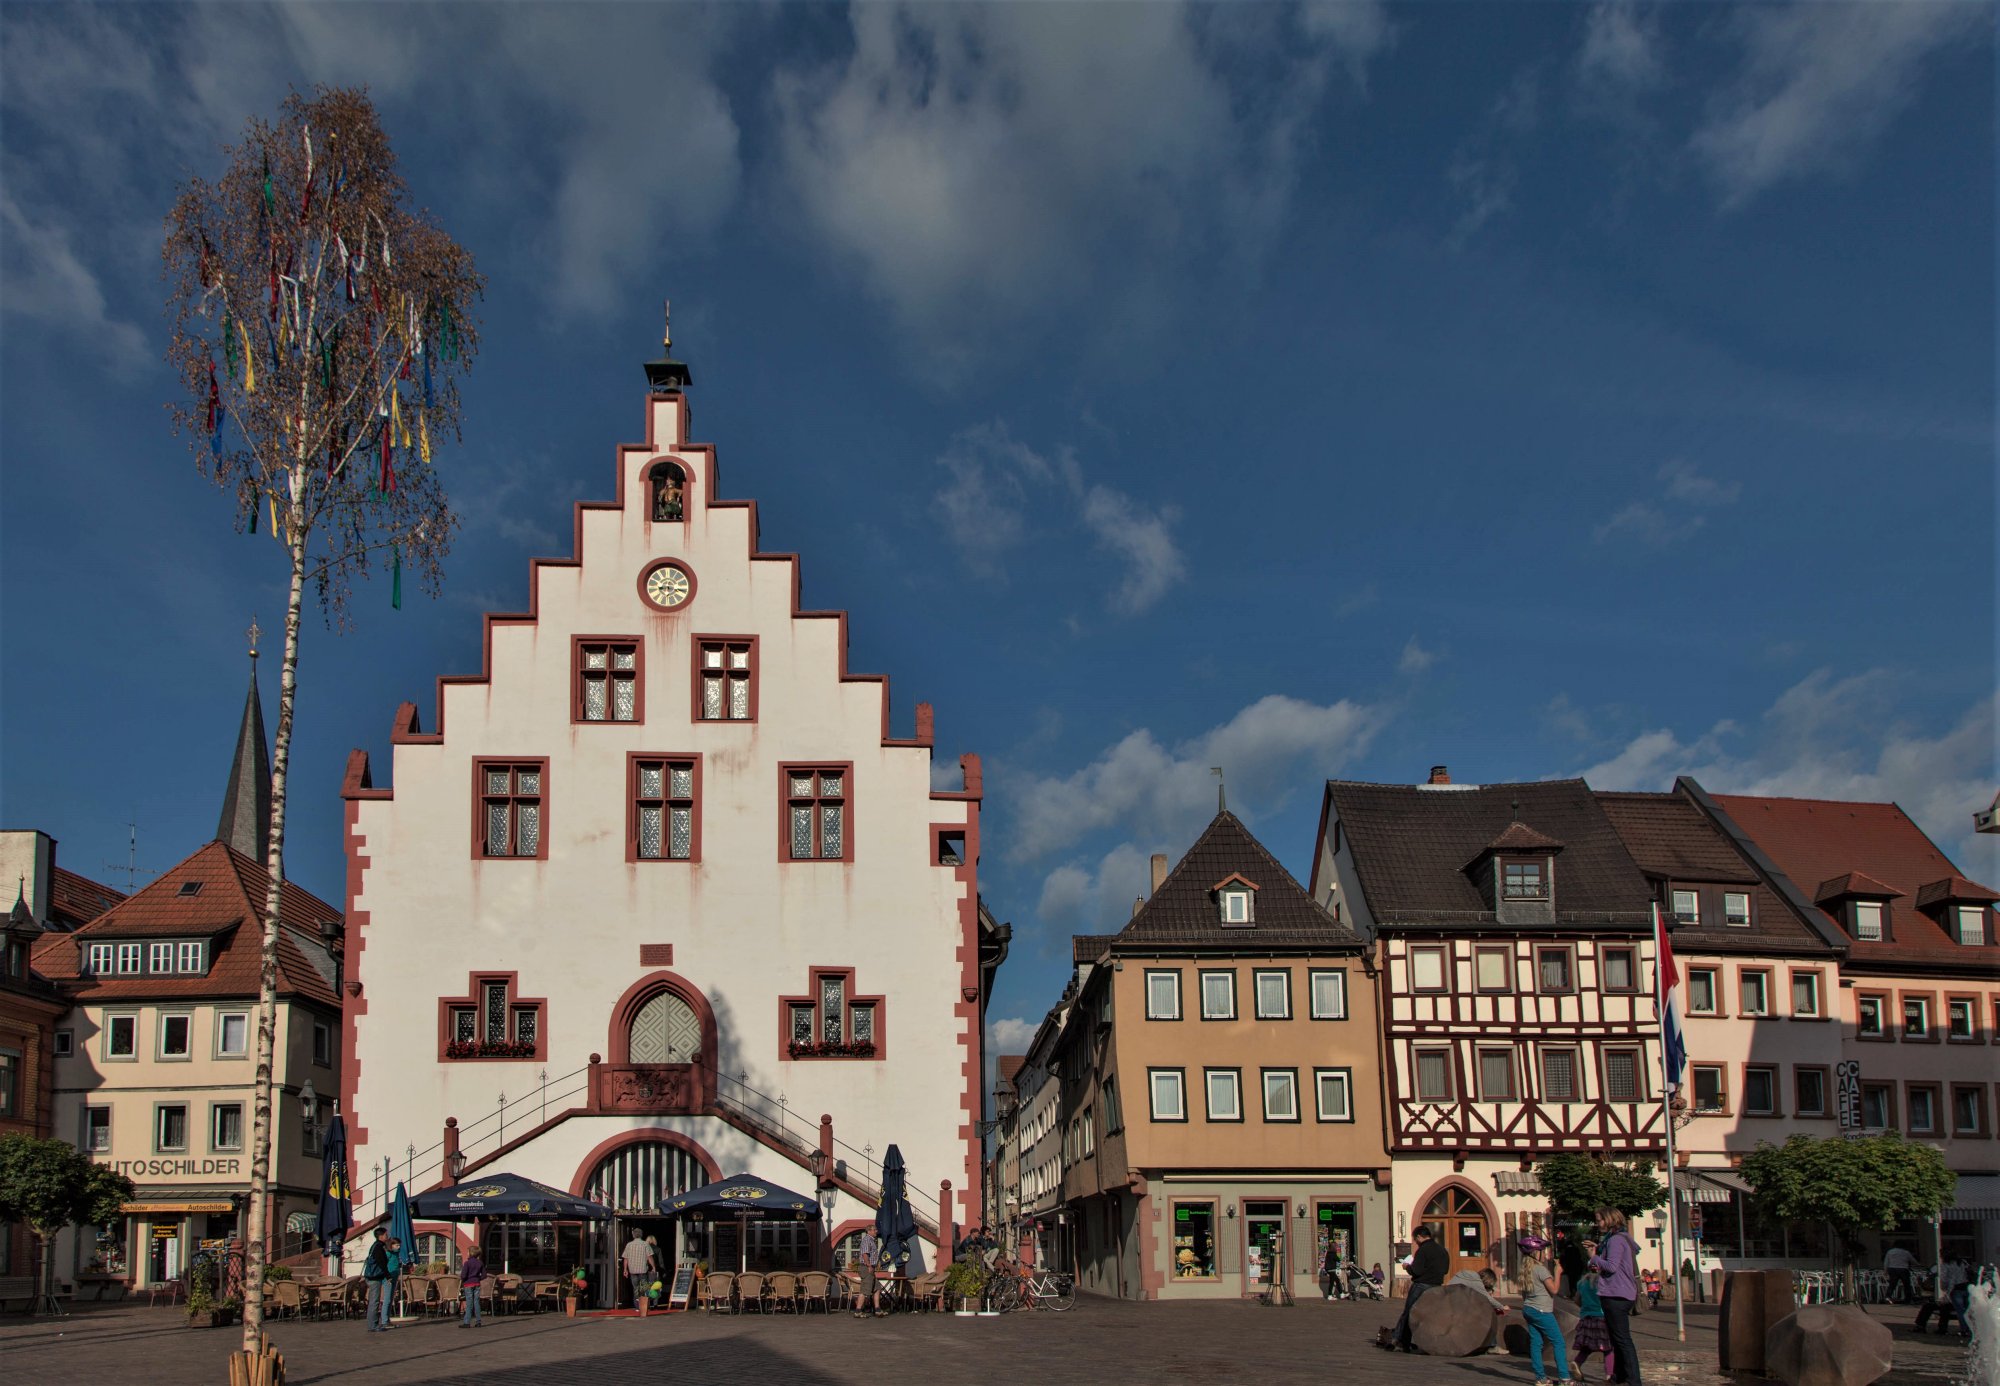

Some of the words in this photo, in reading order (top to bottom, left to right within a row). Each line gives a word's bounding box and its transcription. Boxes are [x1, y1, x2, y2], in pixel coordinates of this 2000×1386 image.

[1837, 1063, 1848, 1126] CAFE
[1847, 1061, 1860, 1126] CAFE
[105, 1159, 240, 1176] UTOSCHILDER
